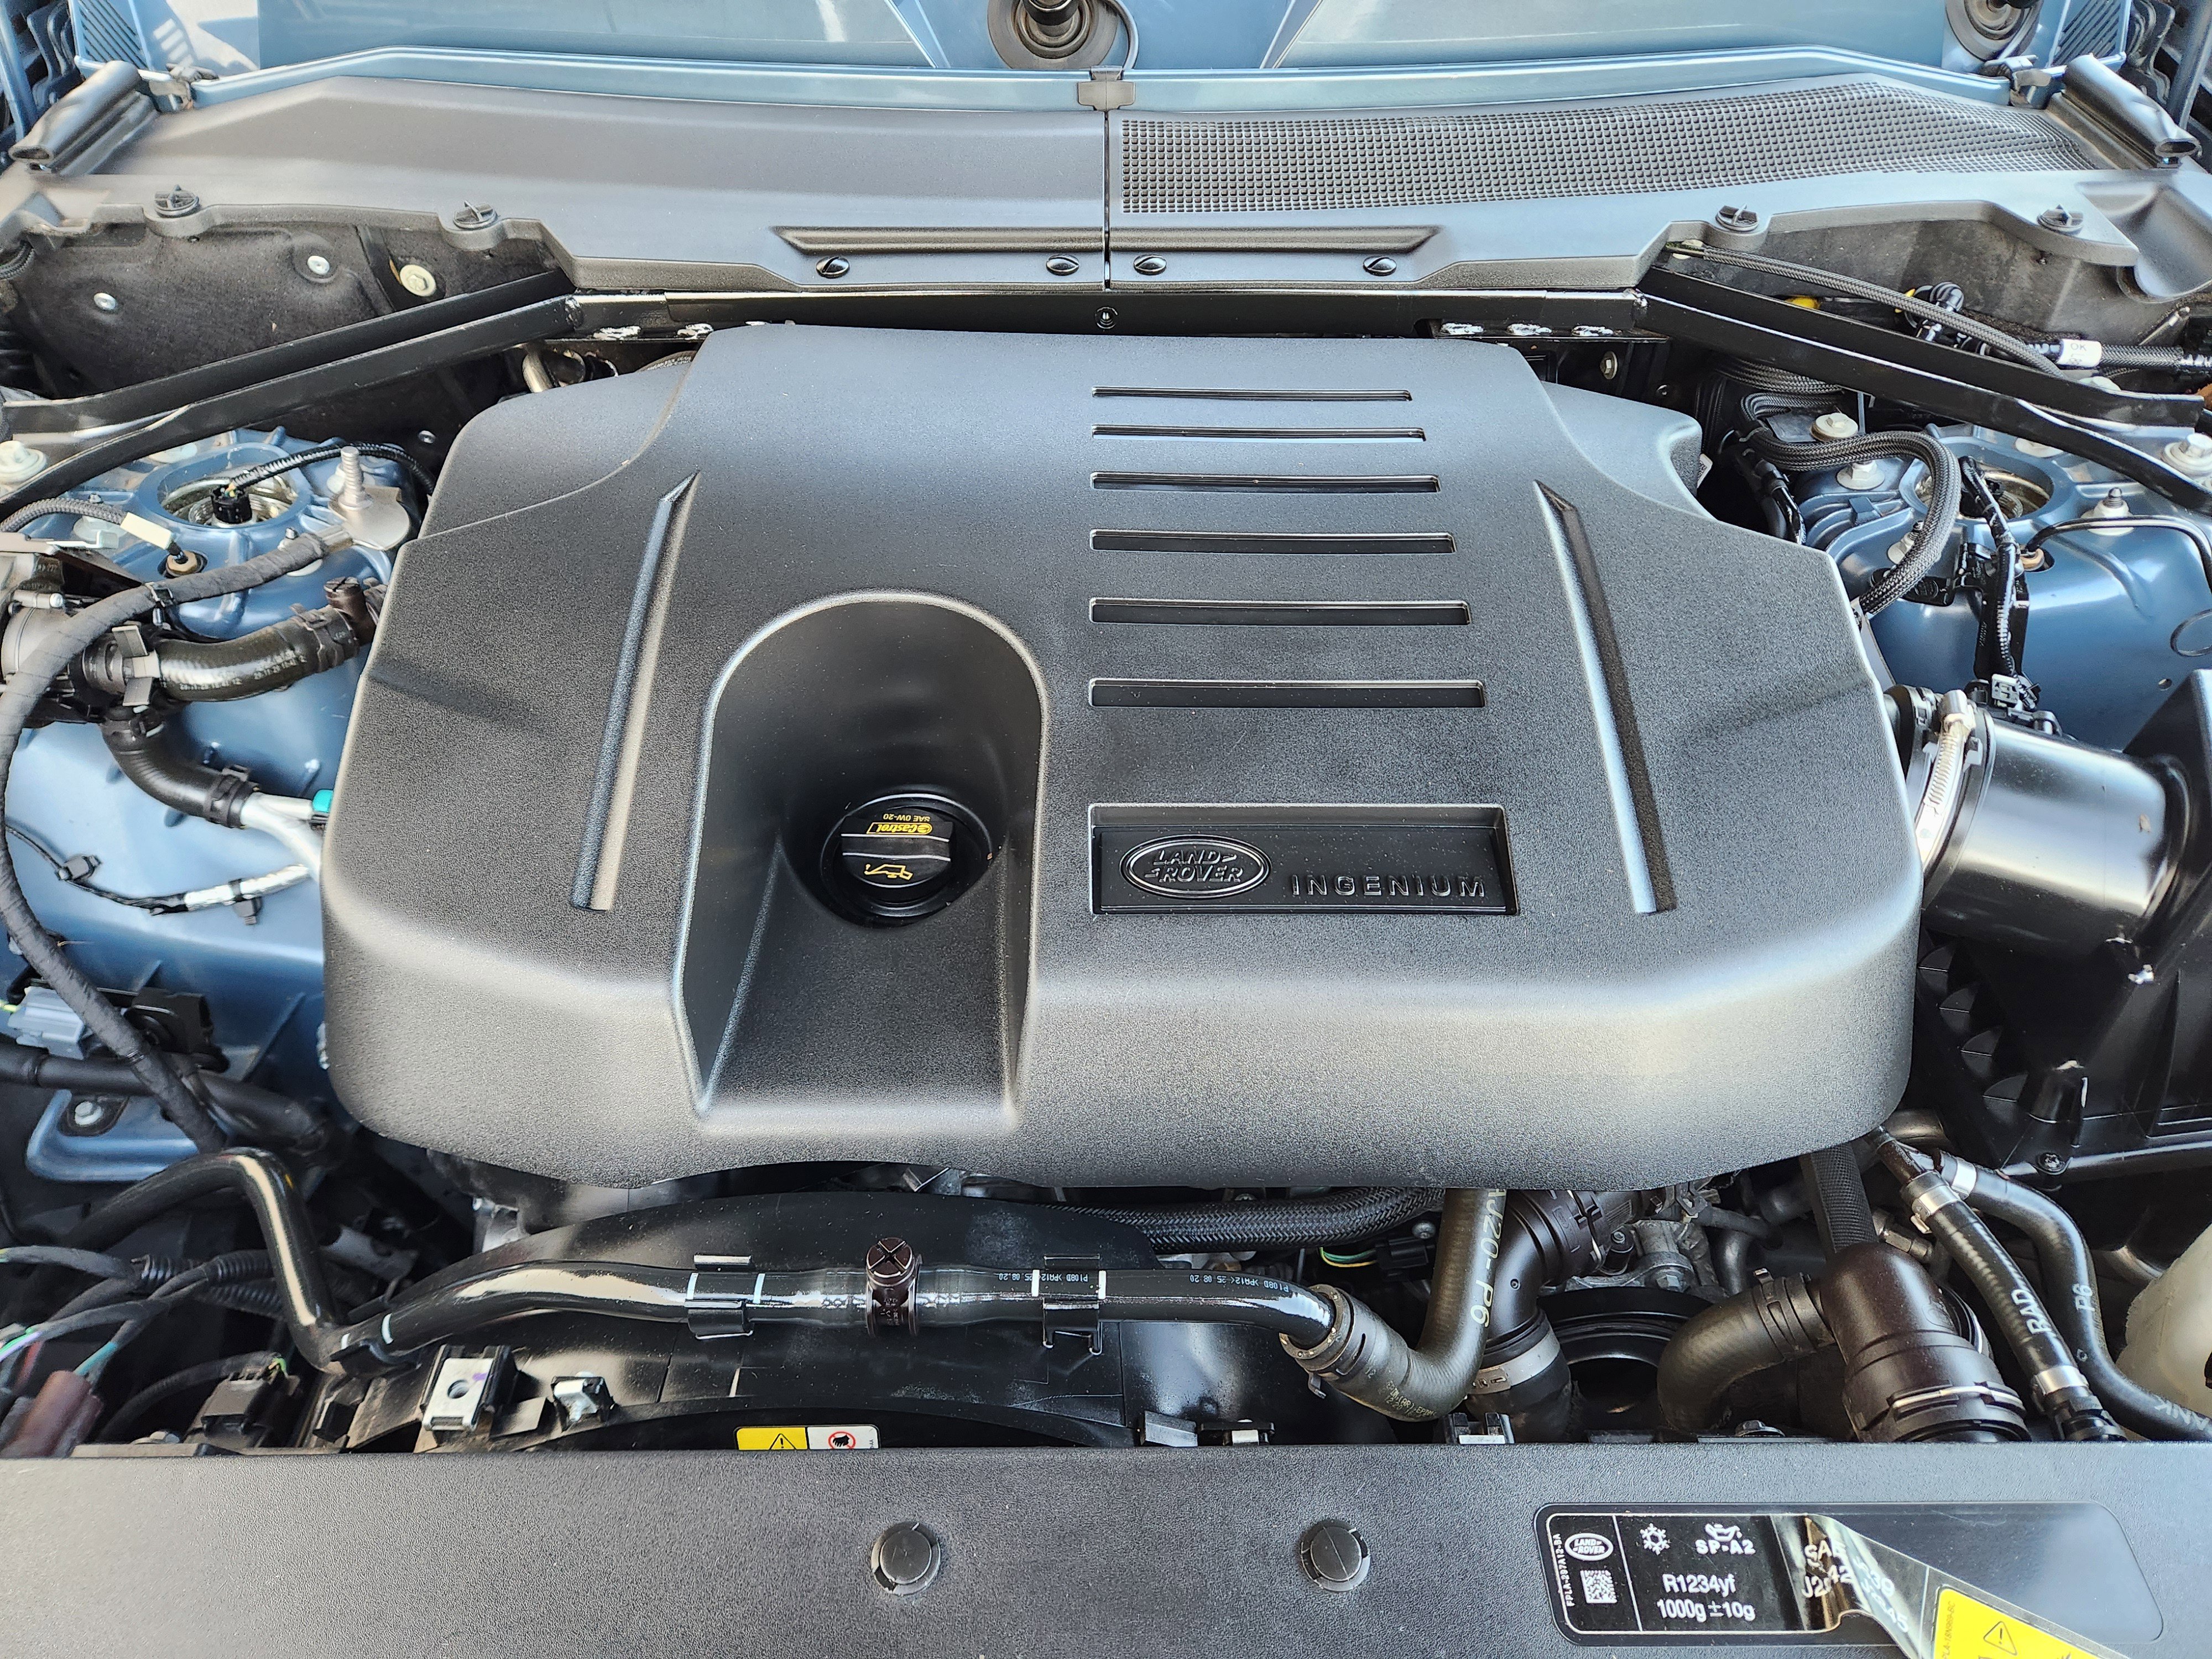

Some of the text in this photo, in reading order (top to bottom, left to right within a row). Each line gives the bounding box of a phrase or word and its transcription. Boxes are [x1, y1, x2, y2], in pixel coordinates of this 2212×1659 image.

[2070, 343, 2087, 352] OK
[883, 813, 911, 822] 0W-20
[875, 823, 918, 833] Castrol
[1153, 849, 1221, 865] LAND
[1159, 865, 1244, 883] ROVER
[1291, 874, 1485, 898] INGENIUM
[2072, 1283, 2095, 1312] P6
[2011, 1288, 2057, 1338] RAD
[1574, 1538, 1597, 1547] LAND
[1577, 1546, 1605, 1554] ROVER
[1695, 1539, 1756, 1555] SP-A2
[1662, 1573, 1736, 1598] R1234yf
[1656, 1599, 1707, 1623] 1000g
